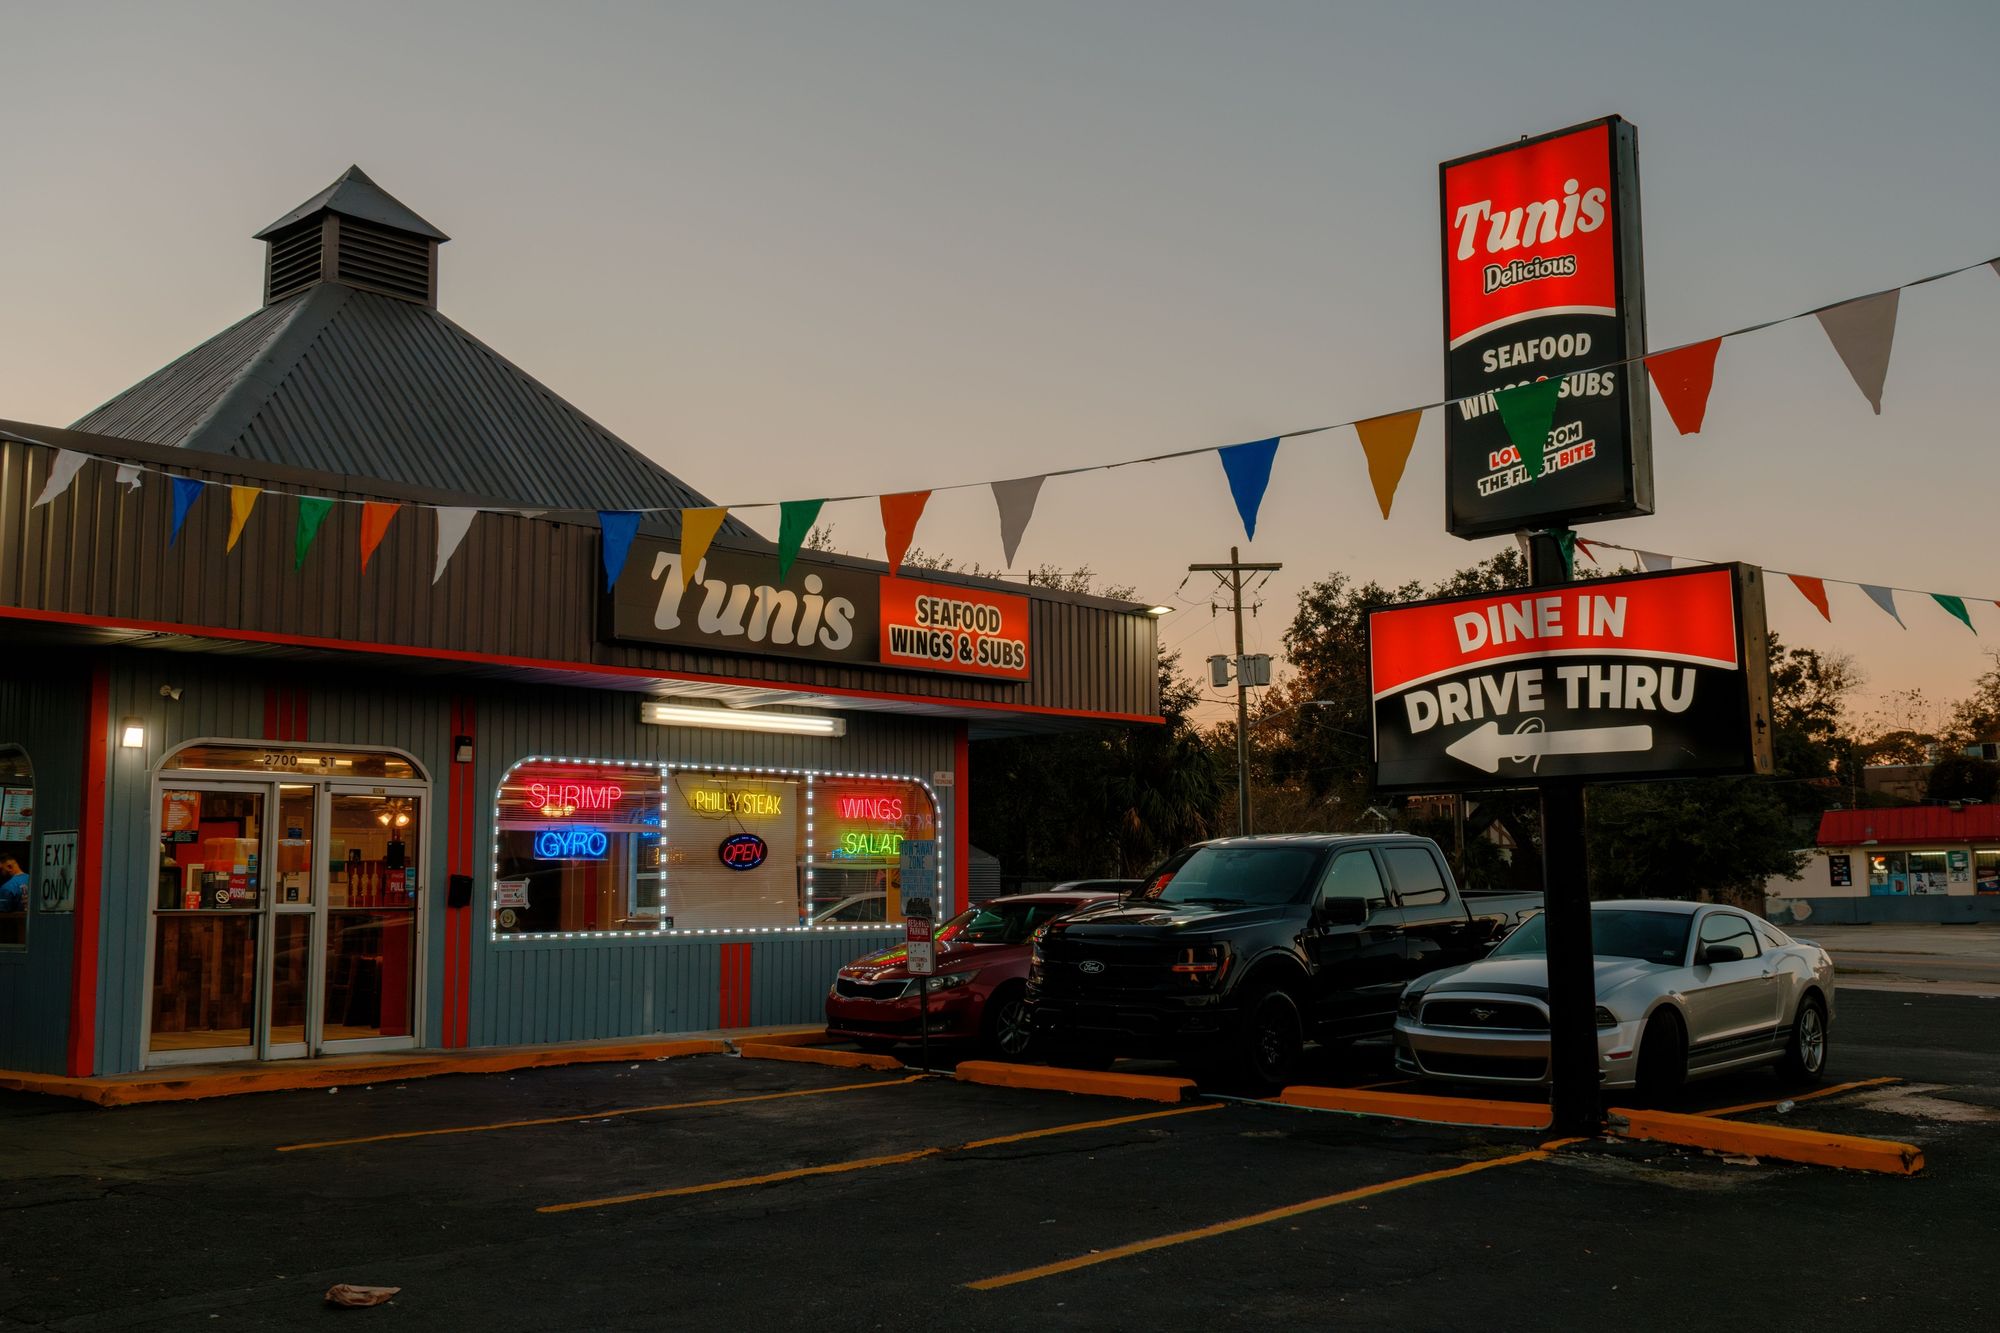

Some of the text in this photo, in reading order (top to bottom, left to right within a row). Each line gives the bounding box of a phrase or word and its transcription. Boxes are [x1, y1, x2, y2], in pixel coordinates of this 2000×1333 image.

[1454, 178, 1606, 261] Tunis
[1484, 255, 1576, 295] Delicious
[1482, 332, 1592, 373] SEAFOOD
[1557, 371, 1615, 398] SUBS
[1488, 420, 1583, 472] LOV ROM
[1478, 472, 1511, 496] THE
[1557, 438, 1596, 470] BITE
[651, 551, 856, 651] Tunis
[915, 594, 1002, 635] SEAFOOD
[1453, 595, 1628, 654] DINE IN
[889, 624, 1026, 671] WINGS & SUBS
[1404, 665, 1697, 734] DRIVE THRU
[264, 754, 336, 767] 2700 ST
[529, 783, 622, 809] SHRIMP
[696, 790, 782, 814] PHILLY STEAK
[842, 798, 903, 819] WINGS
[45, 843, 75, 866] EXIT
[541, 832, 607, 857] GYRO
[723, 843, 763, 862] OPEN
[845, 833, 904, 855] SALAD
[42, 878, 73, 901] ONLY
[229, 886, 246, 899] PUSH
